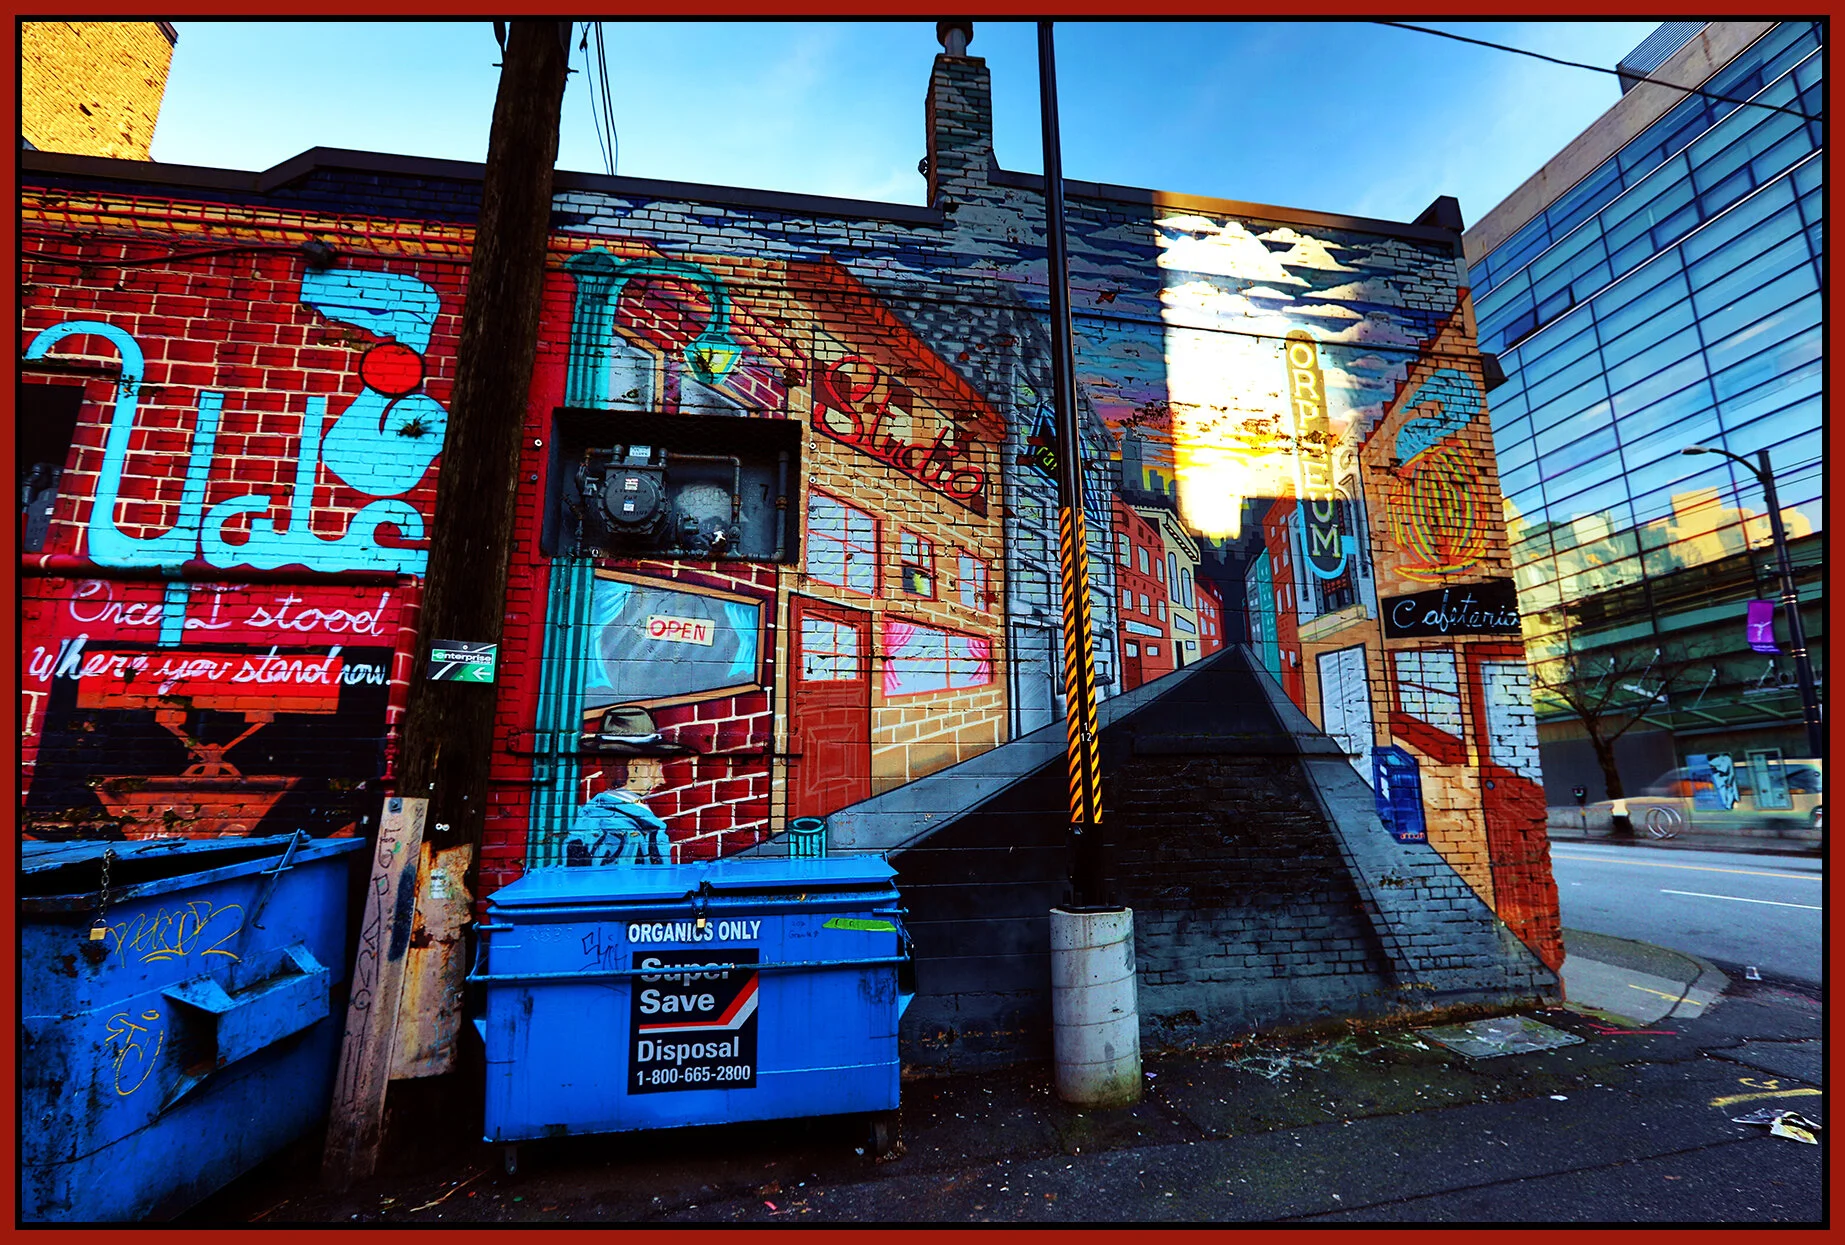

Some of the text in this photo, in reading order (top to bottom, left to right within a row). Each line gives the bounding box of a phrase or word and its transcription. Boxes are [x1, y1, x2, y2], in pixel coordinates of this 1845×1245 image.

[813, 355, 984, 499] Studio
[68, 578, 166, 623] Once
[245, 590, 391, 637] stood
[1392, 589, 1520, 632] Cafeteria
[650, 620, 706, 641] OPEN
[28, 633, 150, 683] Where
[230, 644, 343, 686] stand
[435, 652, 492, 662] enterprise
[1081, 732, 1092, 742] 12
[628, 920, 761, 943] ORGANICS ONLY
[640, 957, 734, 987] Super
[639, 988, 715, 1015] Save
[637, 1036, 740, 1066] Disposal
[636, 1065, 751, 1087] 1-800-665-2800
